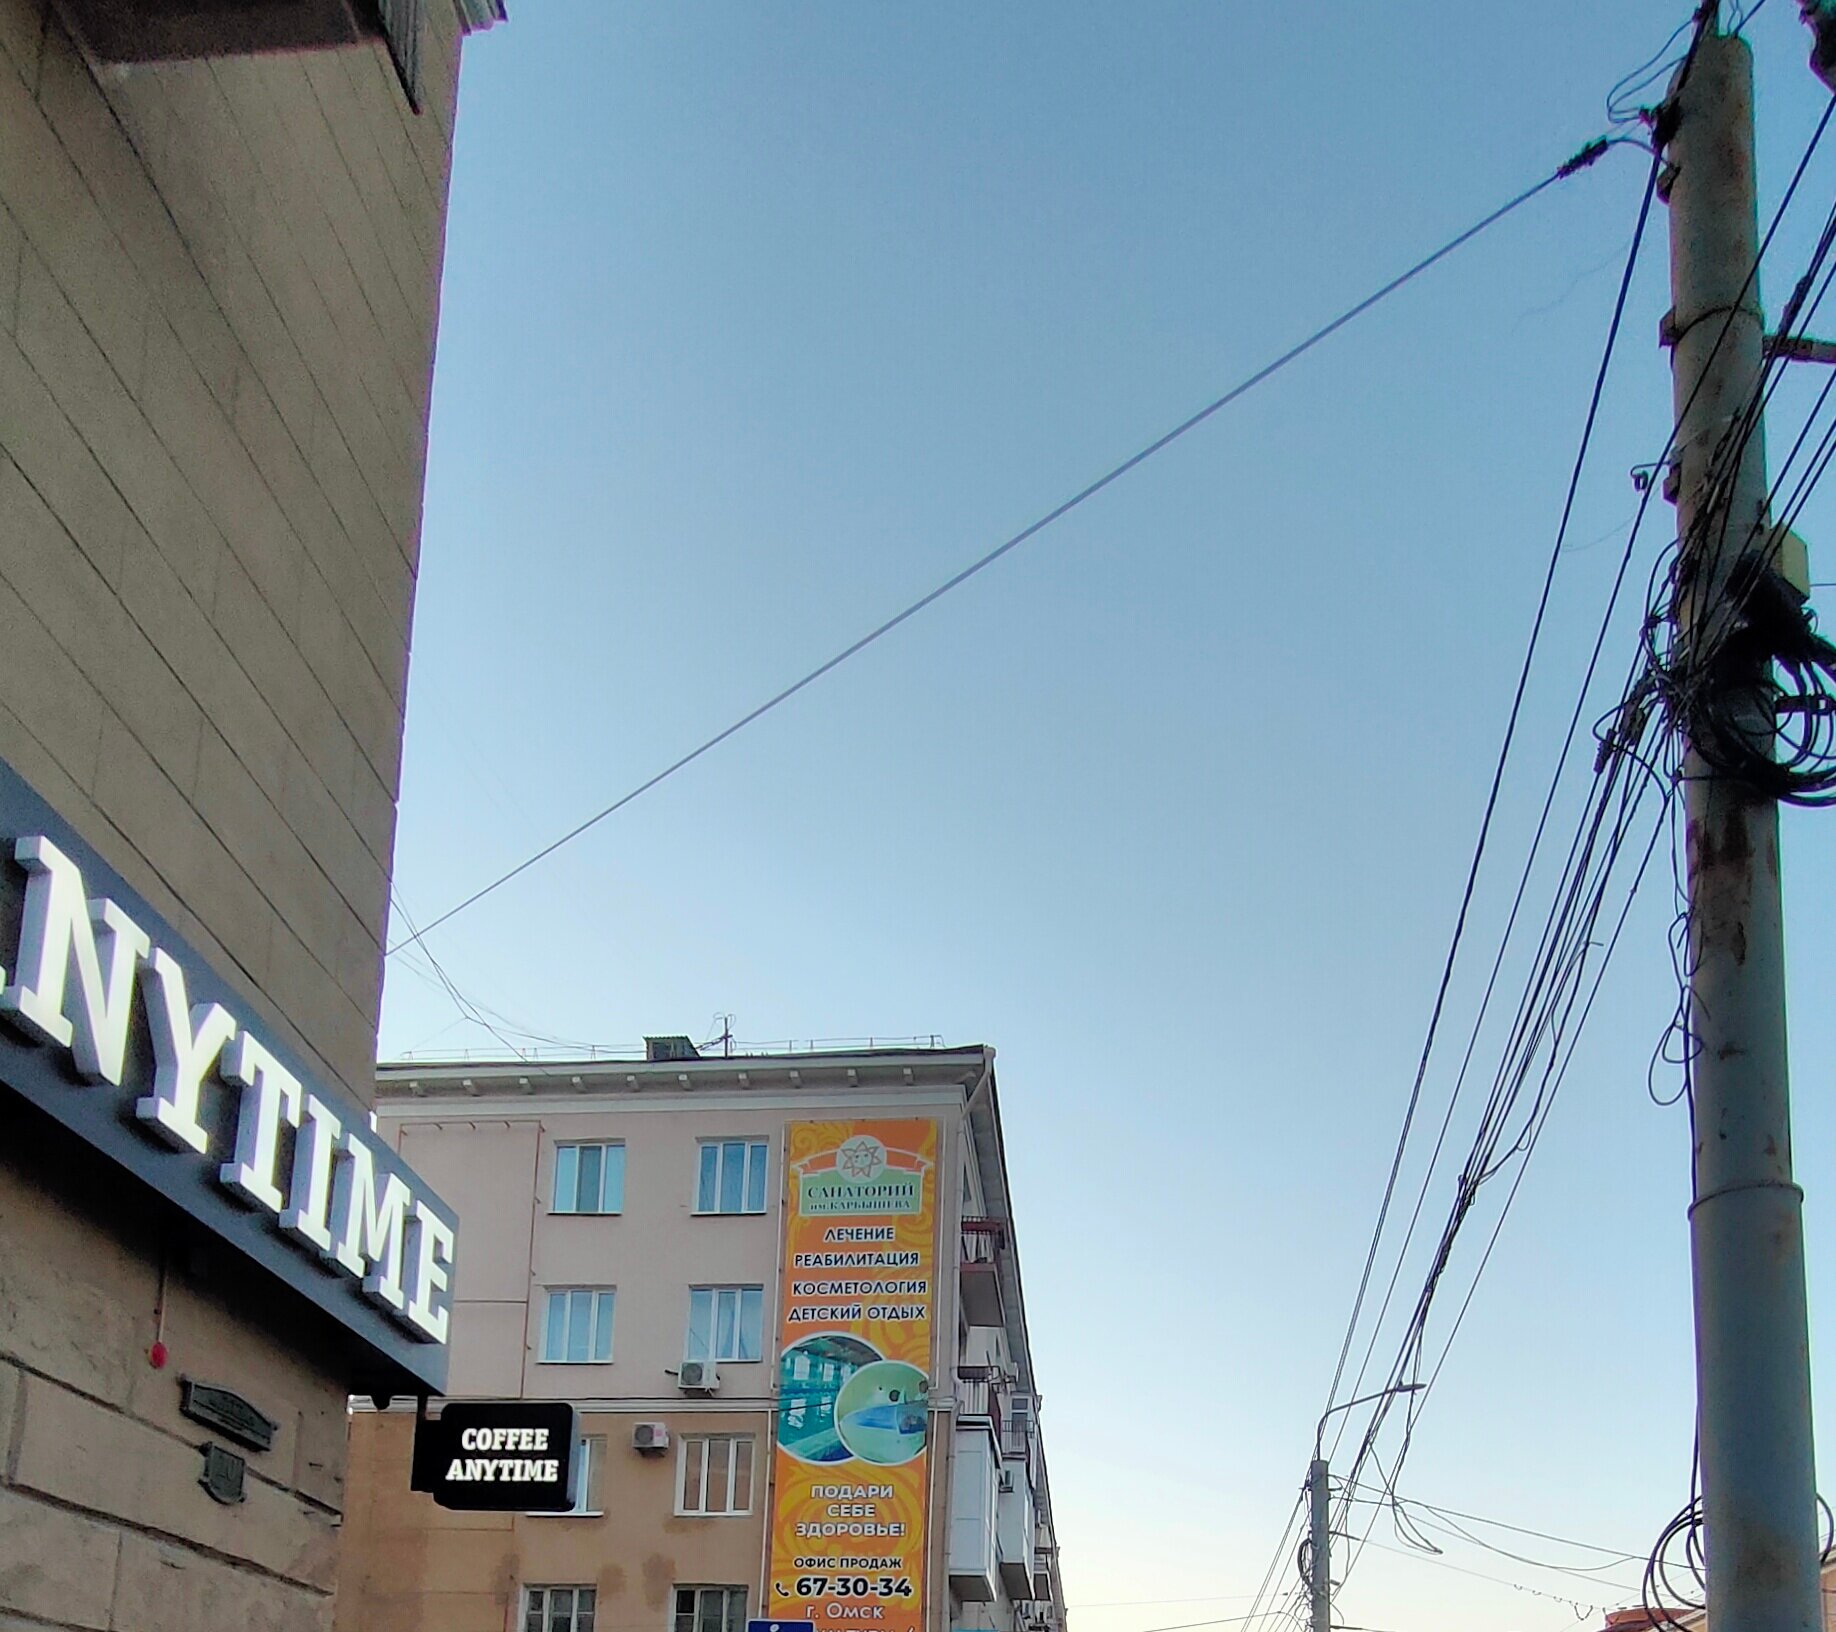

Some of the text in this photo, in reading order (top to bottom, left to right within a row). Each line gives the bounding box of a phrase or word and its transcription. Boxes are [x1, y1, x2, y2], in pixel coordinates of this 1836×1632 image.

[0, 835, 455, 1345] NYTIME
[808, 1182, 914, 1199] САНАТОРИЙ
[824, 1227, 894, 1242] ЛЕЧЕНИЕ
[795, 1252, 919, 1268] РЕАБИЛИТАЦИЯ
[793, 1280, 927, 1296] КОСМЕТОЛОГИЯ
[788, 1304, 925, 1322] ДЕТСКИЙ ОТДЫХ
[461, 1428, 550, 1451] COFFEE
[445, 1459, 559, 1482] ANYTIME
[811, 1485, 893, 1499] ПОДАРИ
[827, 1504, 876, 1518] СЕБЕ
[795, 1523, 906, 1537] ЗДОРОВЬЕ!
[794, 1557, 902, 1569] ОФИС ПРОДАЖ
[796, 1577, 912, 1597] 67-30-34
[806, 1602, 884, 1620] г. Омск
